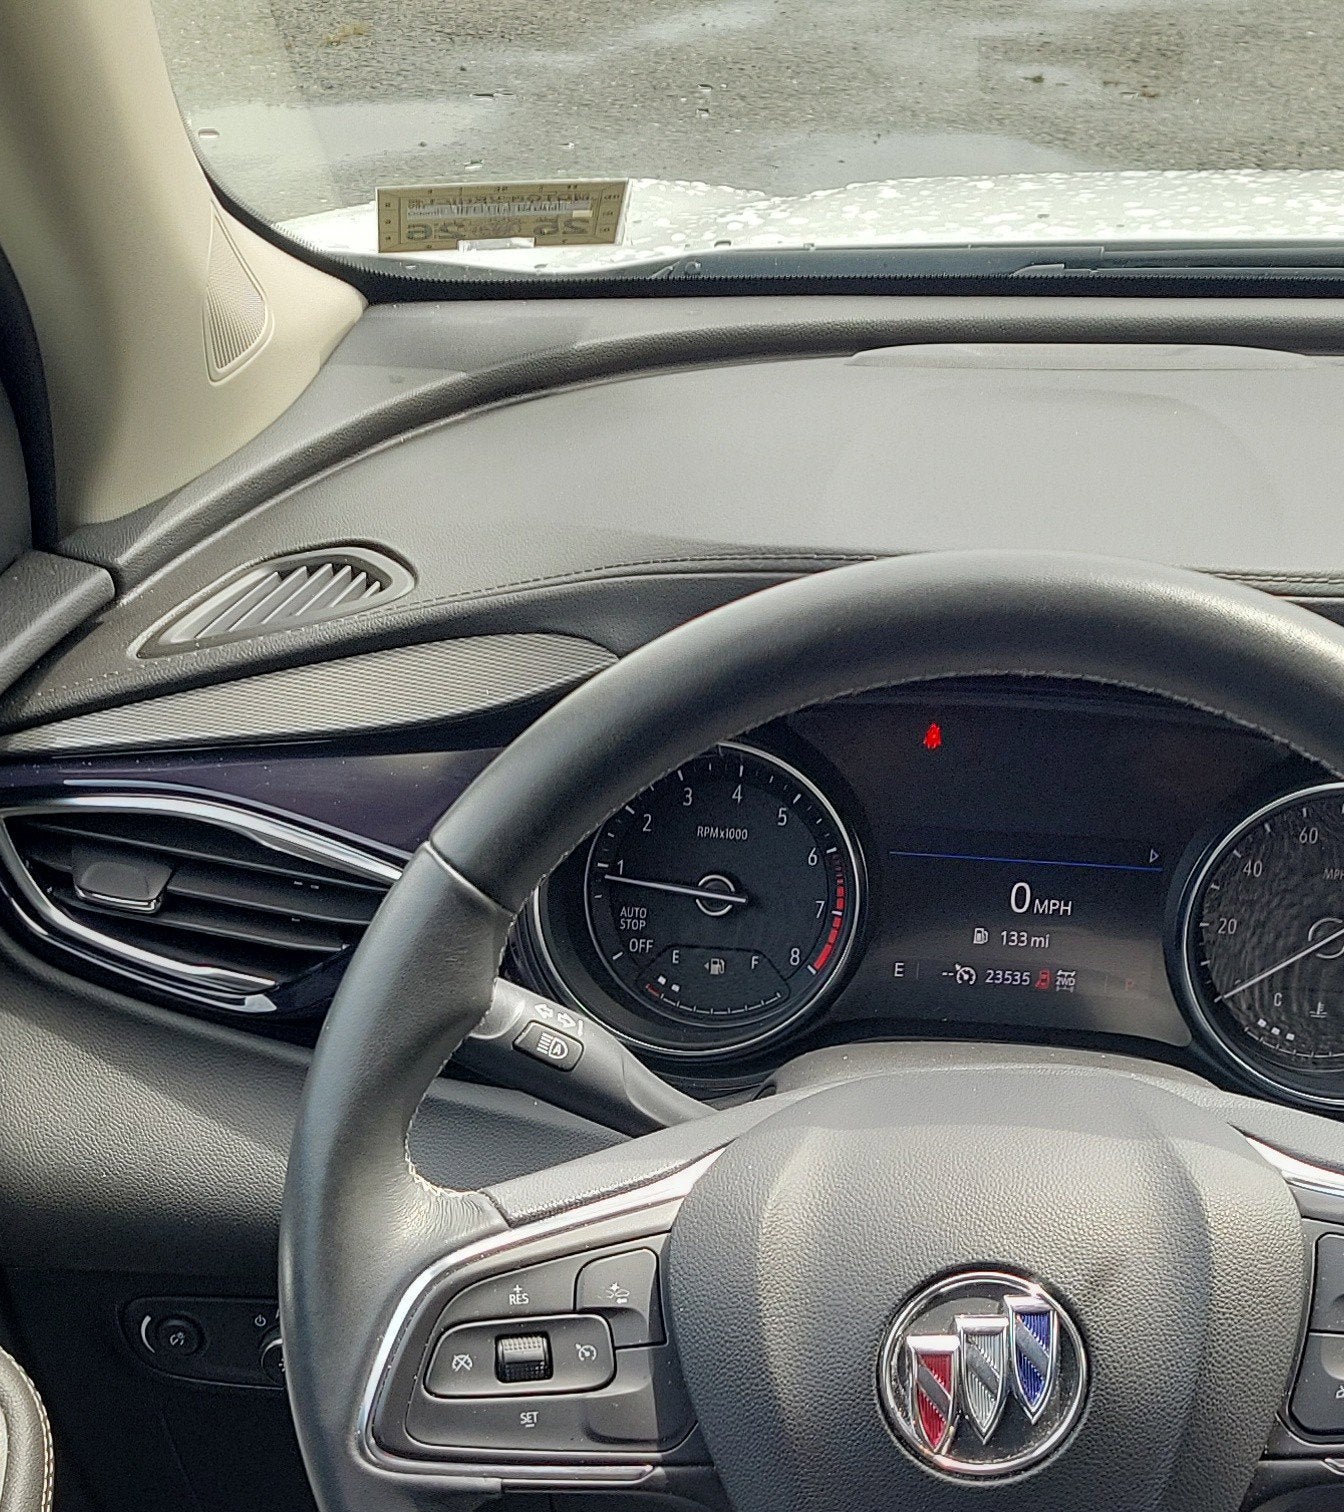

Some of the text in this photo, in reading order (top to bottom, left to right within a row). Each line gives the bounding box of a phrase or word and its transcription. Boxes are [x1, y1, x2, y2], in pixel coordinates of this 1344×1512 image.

[682, 787, 693, 806] 3
[732, 785, 743, 803] 4
[642, 814, 652, 832] 2
[777, 807, 787, 826] 5
[696, 826, 748, 840] RPMx1000
[1298, 827, 1319, 844] 60
[807, 847, 818, 865] 6
[617, 859, 625, 874] 1
[1242, 860, 1263, 878] 40
[1009, 882, 1073, 916] 0 MPH
[619, 906, 647, 919] AUTO
[815, 900, 826, 919] 7
[619, 918, 646, 930] STOP
[1217, 918, 1238, 934] 20
[629, 938, 654, 953] OFF
[1000, 930, 1050, 948] 133 mi
[672, 950, 680, 964] E
[750, 956, 759, 970] F
[789, 947, 800, 966] 8
[894, 962, 904, 977] E
[985, 969, 1032, 985] 23535
[1273, 992, 1282, 1007] C
[508, 1292, 530, 1306] RES
[519, 1411, 539, 1425] SET
